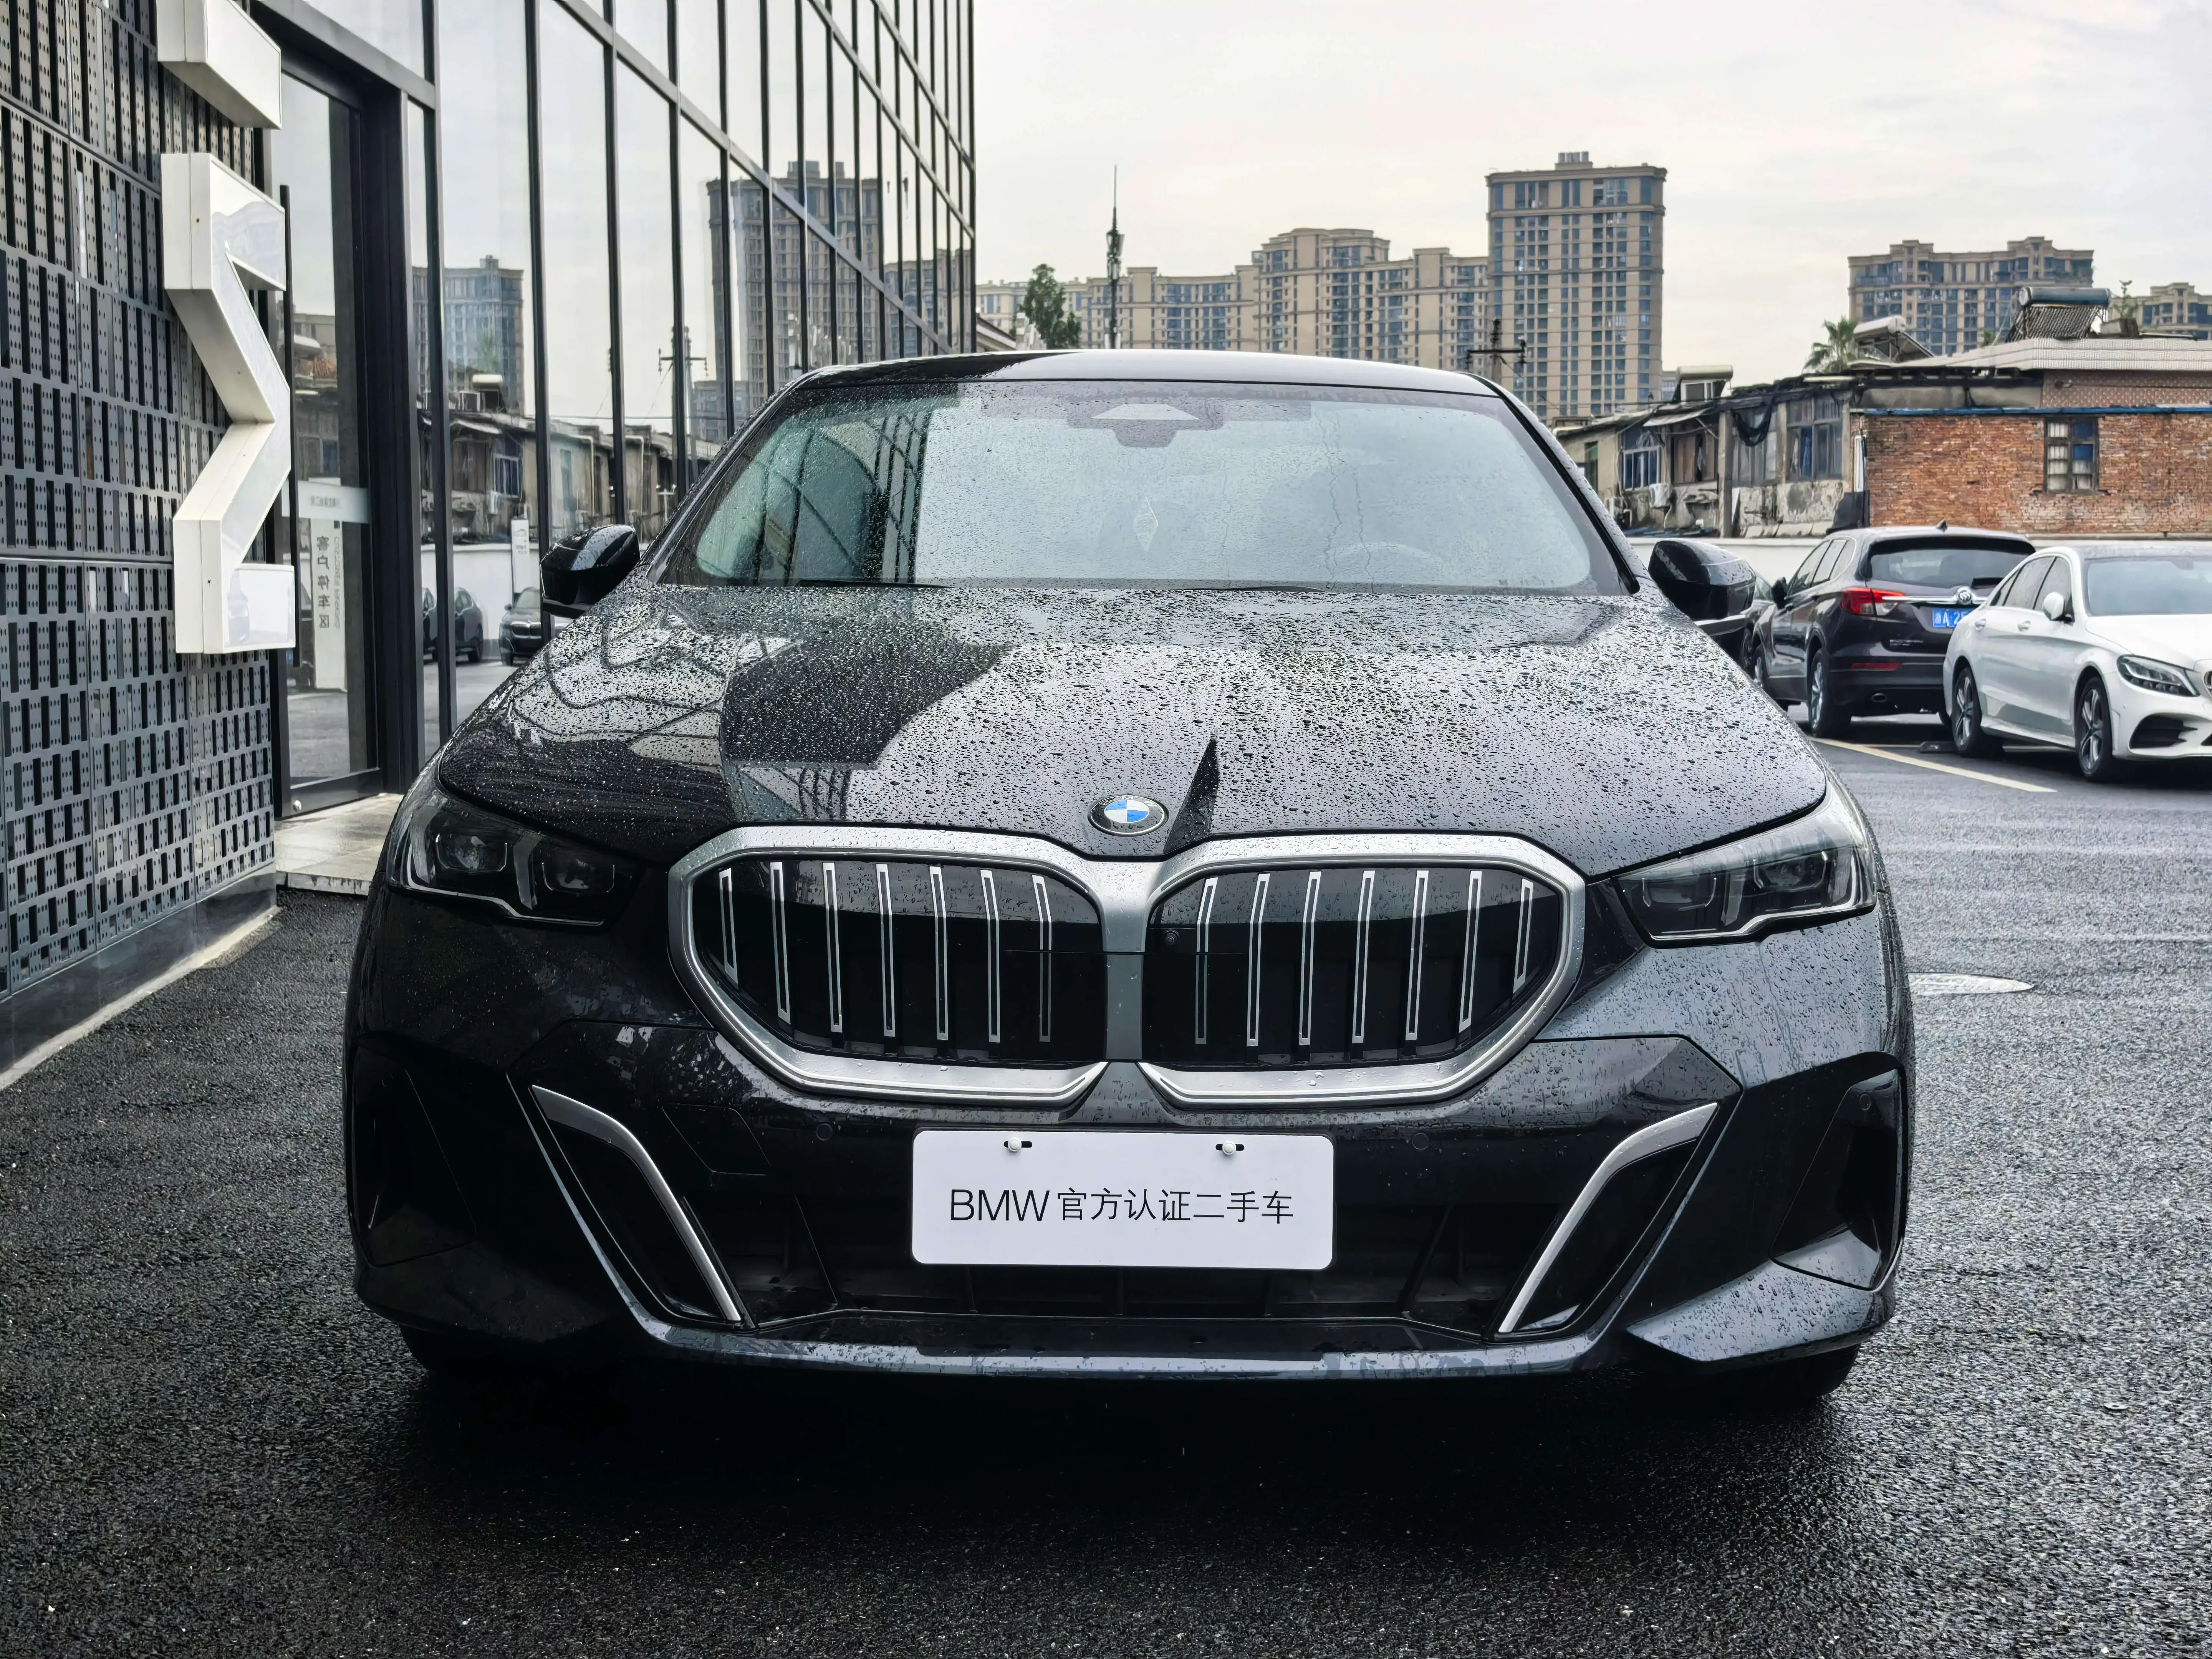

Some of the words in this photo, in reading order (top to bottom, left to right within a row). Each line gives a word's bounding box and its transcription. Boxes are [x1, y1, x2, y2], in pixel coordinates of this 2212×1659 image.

[1099, 796, 1157, 806] BMW
[951, 1189, 1050, 1221] BMW
[1057, 1187, 1293, 1224] 官方认证二手车
